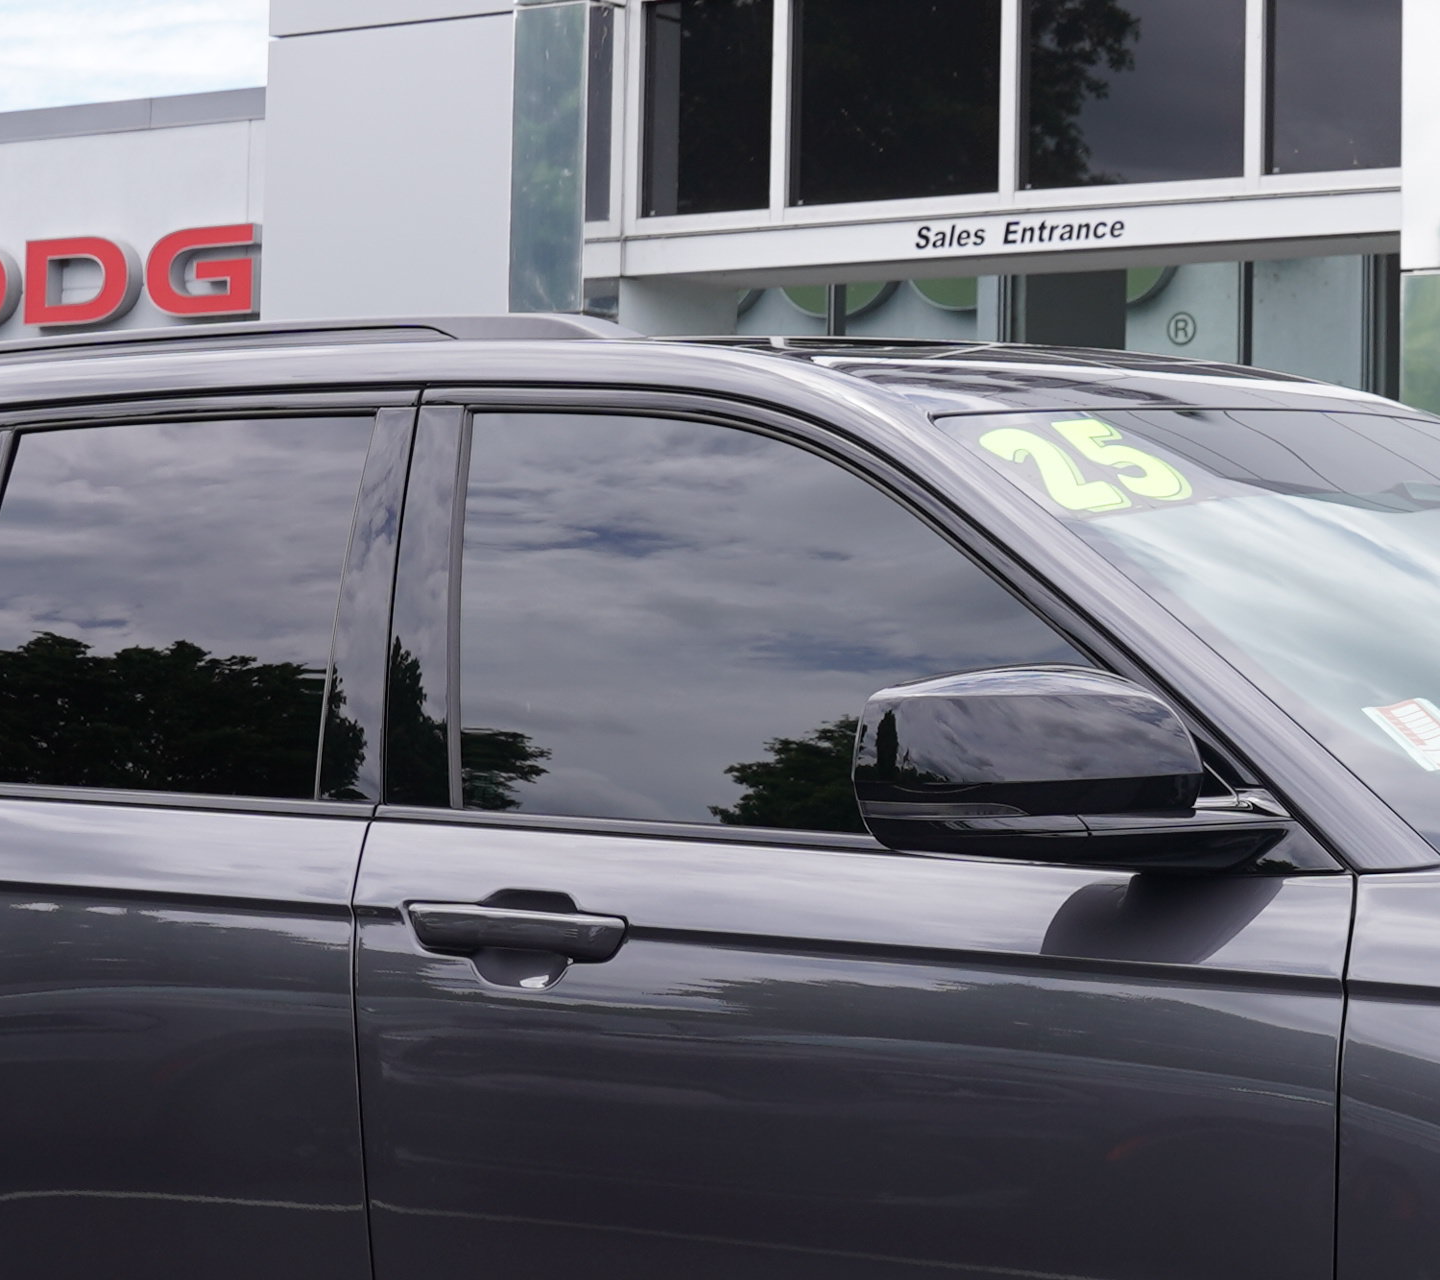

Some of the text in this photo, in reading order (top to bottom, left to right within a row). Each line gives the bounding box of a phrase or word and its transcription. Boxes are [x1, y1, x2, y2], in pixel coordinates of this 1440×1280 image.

[915, 220, 1126, 250] Sales Entrance
[978, 419, 1193, 513] 25
